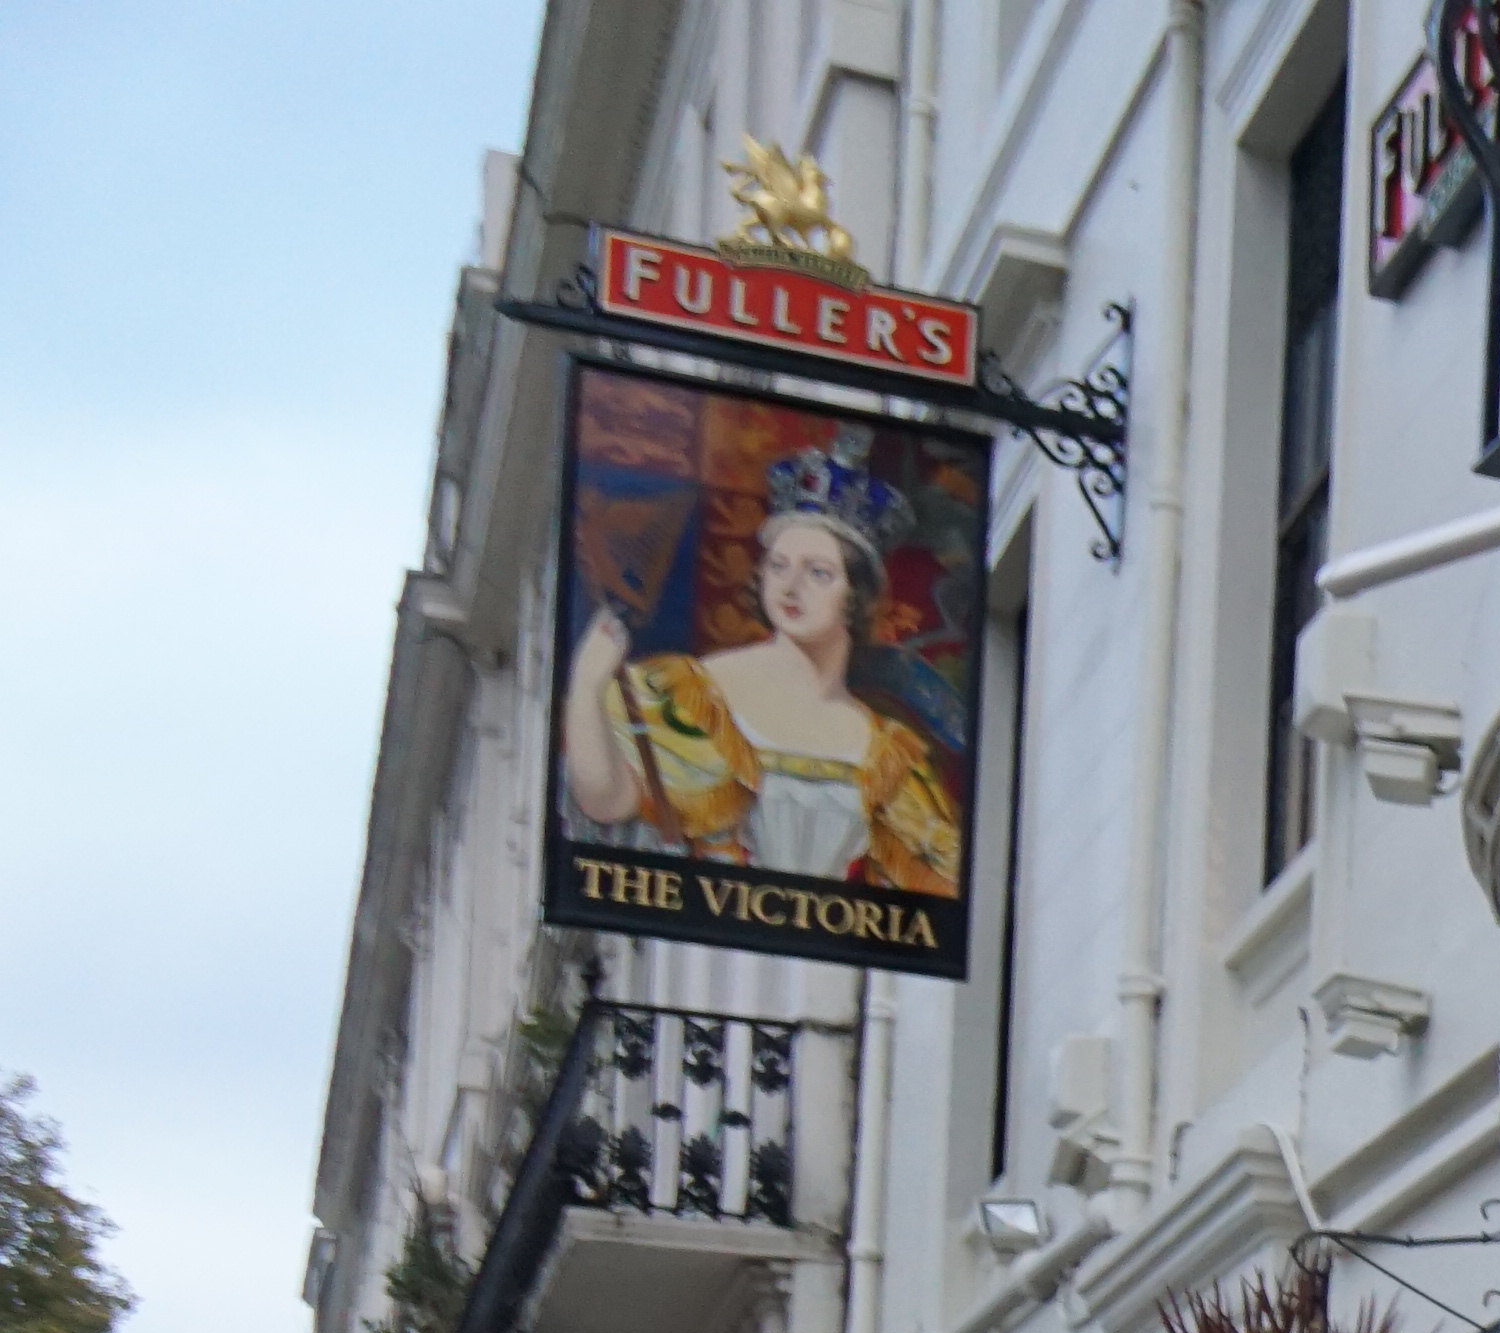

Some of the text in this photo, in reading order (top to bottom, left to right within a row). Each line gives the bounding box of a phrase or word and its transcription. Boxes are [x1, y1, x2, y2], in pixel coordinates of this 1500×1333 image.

[622, 245, 955, 368] FULLER'S
[574, 855, 939, 952] THE VICTORIA
